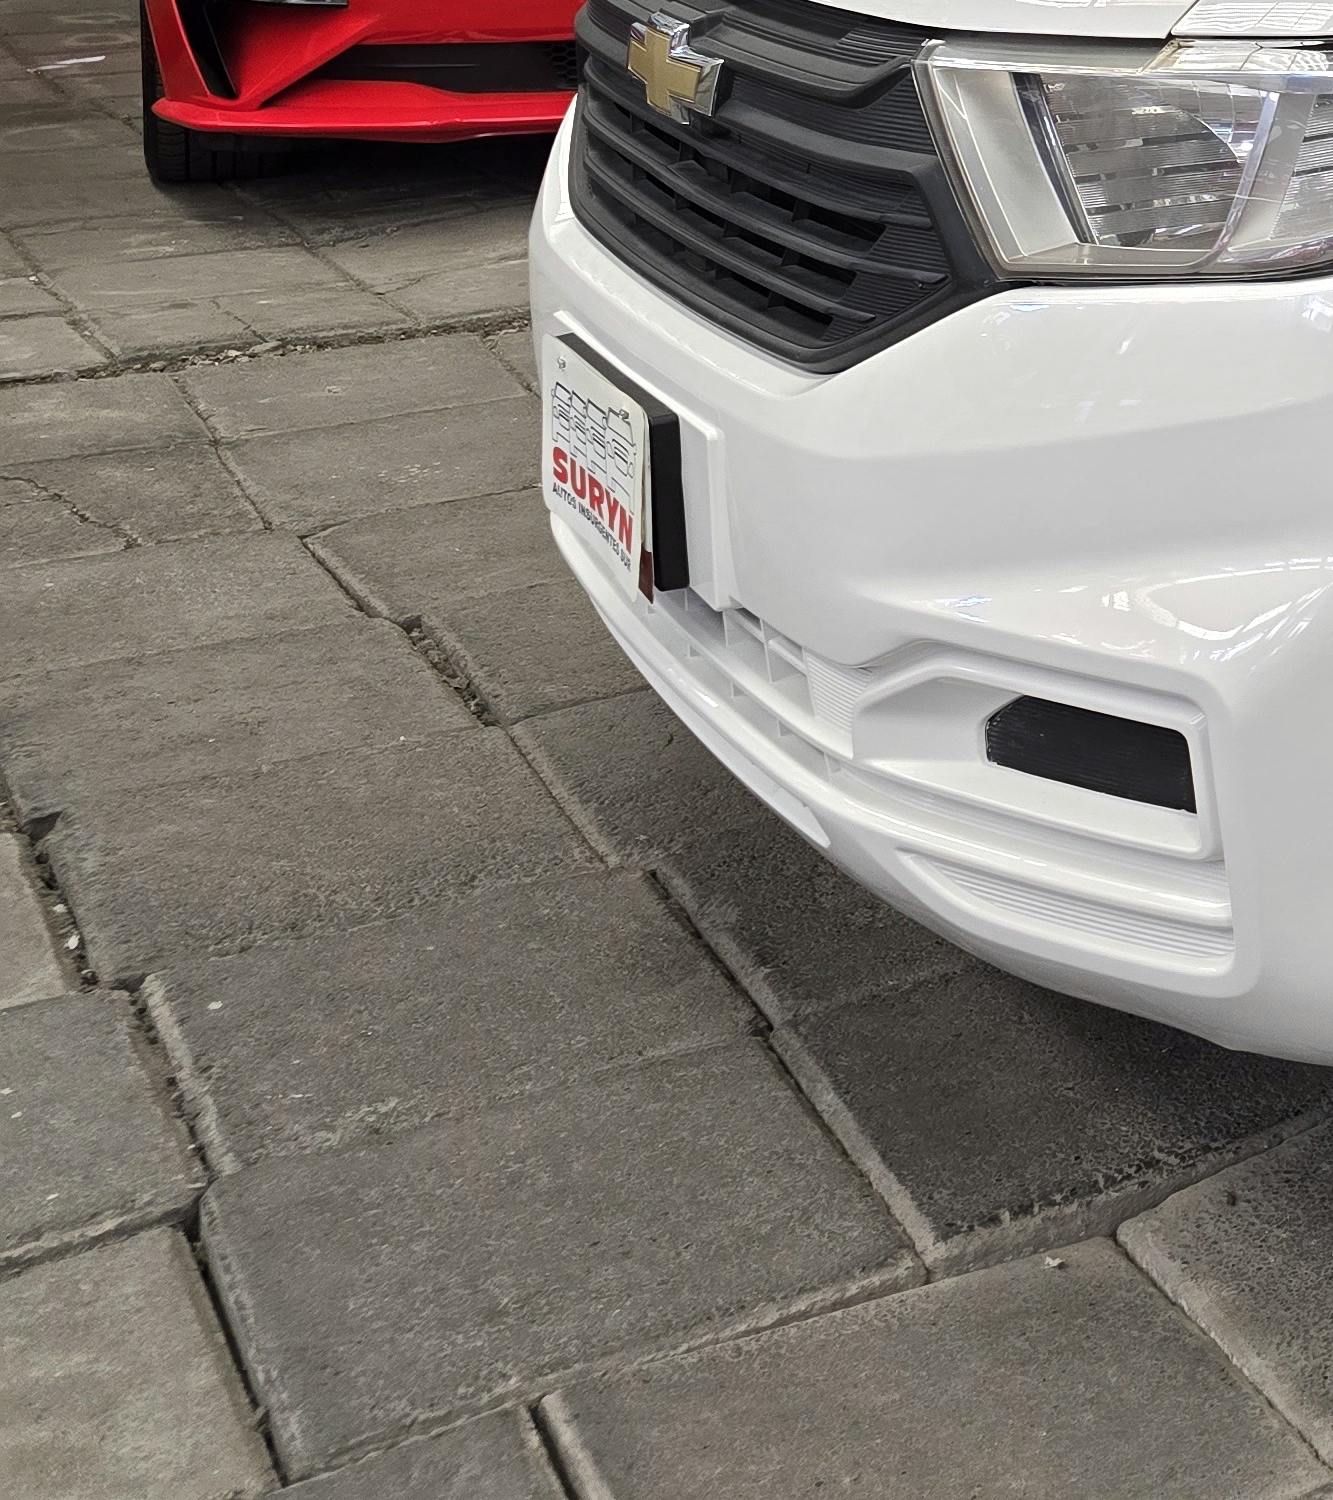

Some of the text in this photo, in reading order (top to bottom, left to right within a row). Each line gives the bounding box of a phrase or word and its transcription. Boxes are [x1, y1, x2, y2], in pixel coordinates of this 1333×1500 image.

[552, 446, 634, 555] SURYN
[552, 482, 632, 573] AUTOS INSURGENTES SUR
